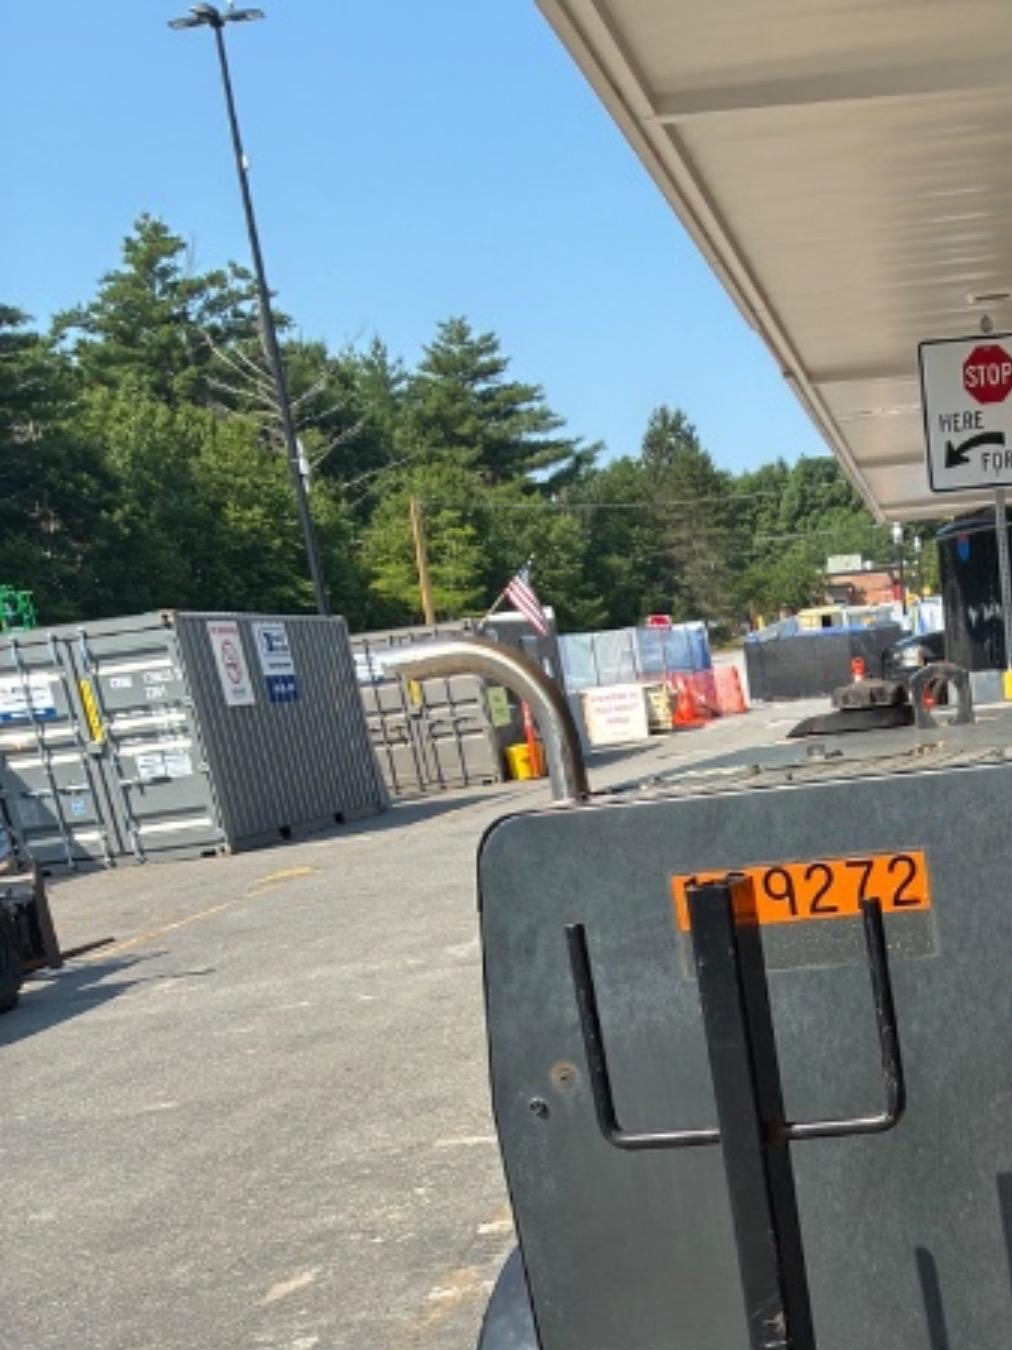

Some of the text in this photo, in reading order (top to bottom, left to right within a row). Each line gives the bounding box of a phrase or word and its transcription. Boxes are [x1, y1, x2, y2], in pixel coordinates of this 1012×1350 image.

[965, 363, 1012, 389] STOP
[938, 411, 985, 433] HERE
[684, 855, 922, 917] 9272
